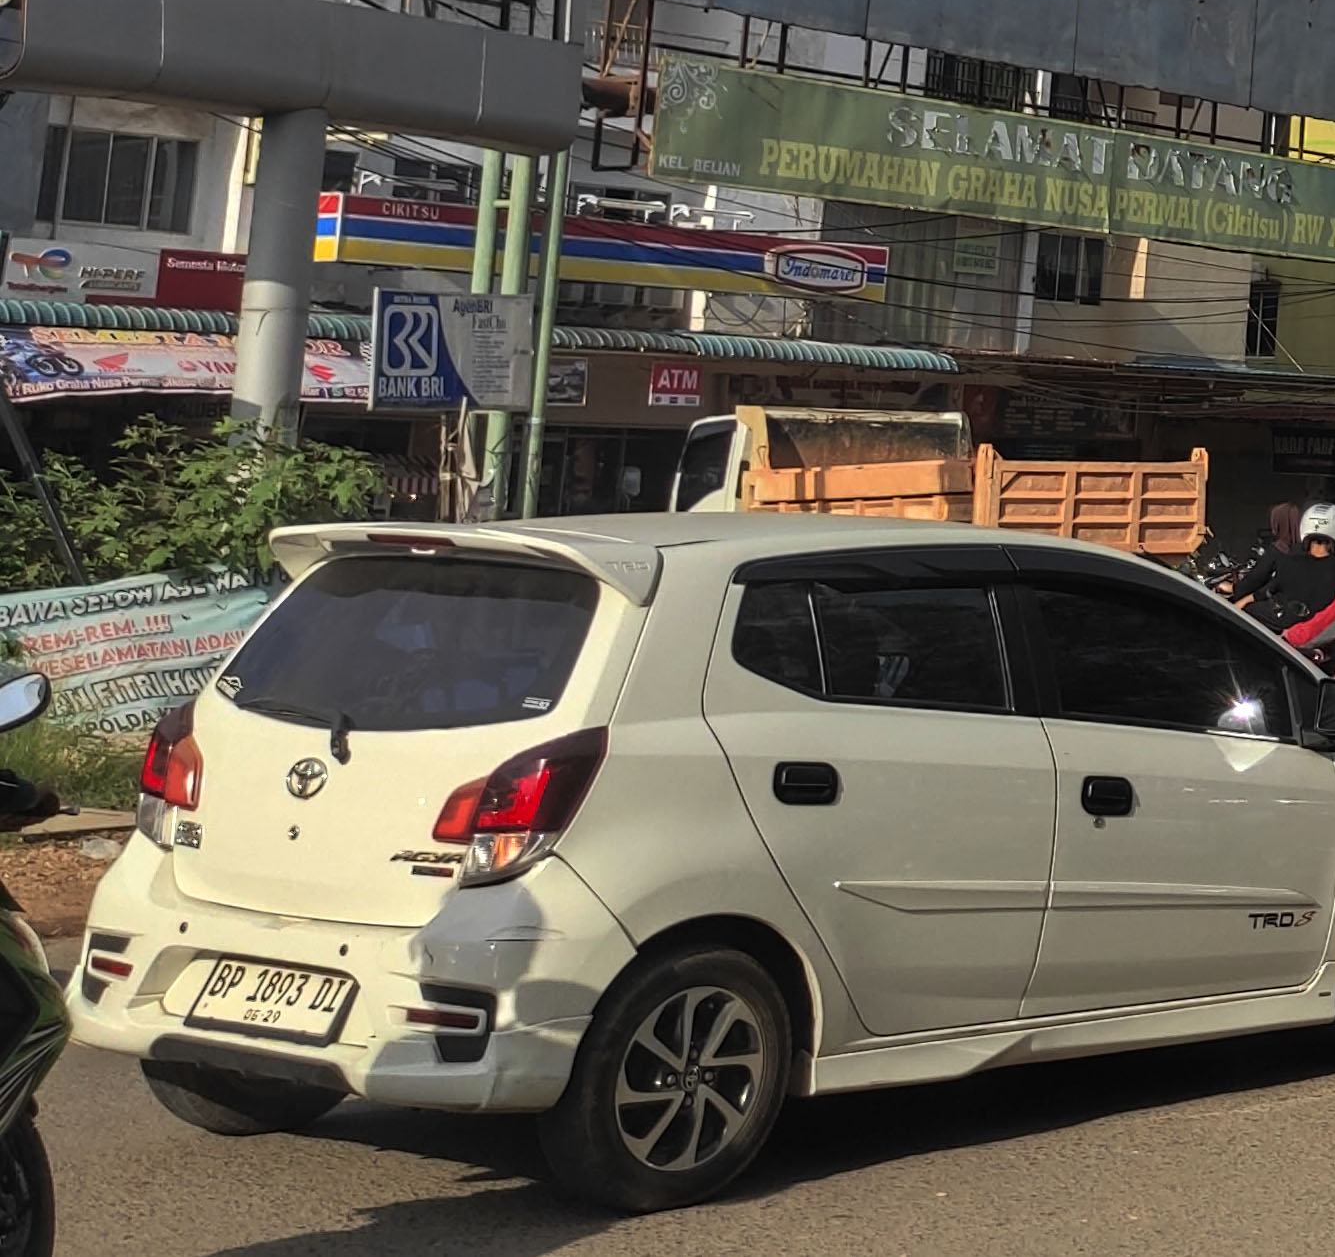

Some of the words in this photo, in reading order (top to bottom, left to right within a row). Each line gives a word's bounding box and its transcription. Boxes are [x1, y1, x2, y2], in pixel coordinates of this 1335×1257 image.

[693, 156, 741, 177] BELIAN
[759, 138, 940, 197] PERUMAHAN
[948, 164, 1036, 209] GRAHA
[1044, 177, 1109, 216] NUSA
[1112, 189, 1199, 231] PERMAI
[1202, 196, 1288, 243] (Cikitsu)
[1292, 212, 1324, 246] RW
[381, 201, 440, 221] CIKITSU
[780, 255, 857, 285] Indomaret
[22, 381, 55, 396] Ruko
[378, 375, 418, 398] BANK
[420, 375, 445, 397] BRI
[657, 367, 698, 390] ATM
[72, 584, 154, 616] SELOW
[389, 849, 464, 864] AGYA
[1247, 911, 1295, 930] TRD
[208, 963, 246, 999] BP
[245, 968, 312, 1007] 1893
[307, 976, 348, 1013] DI
